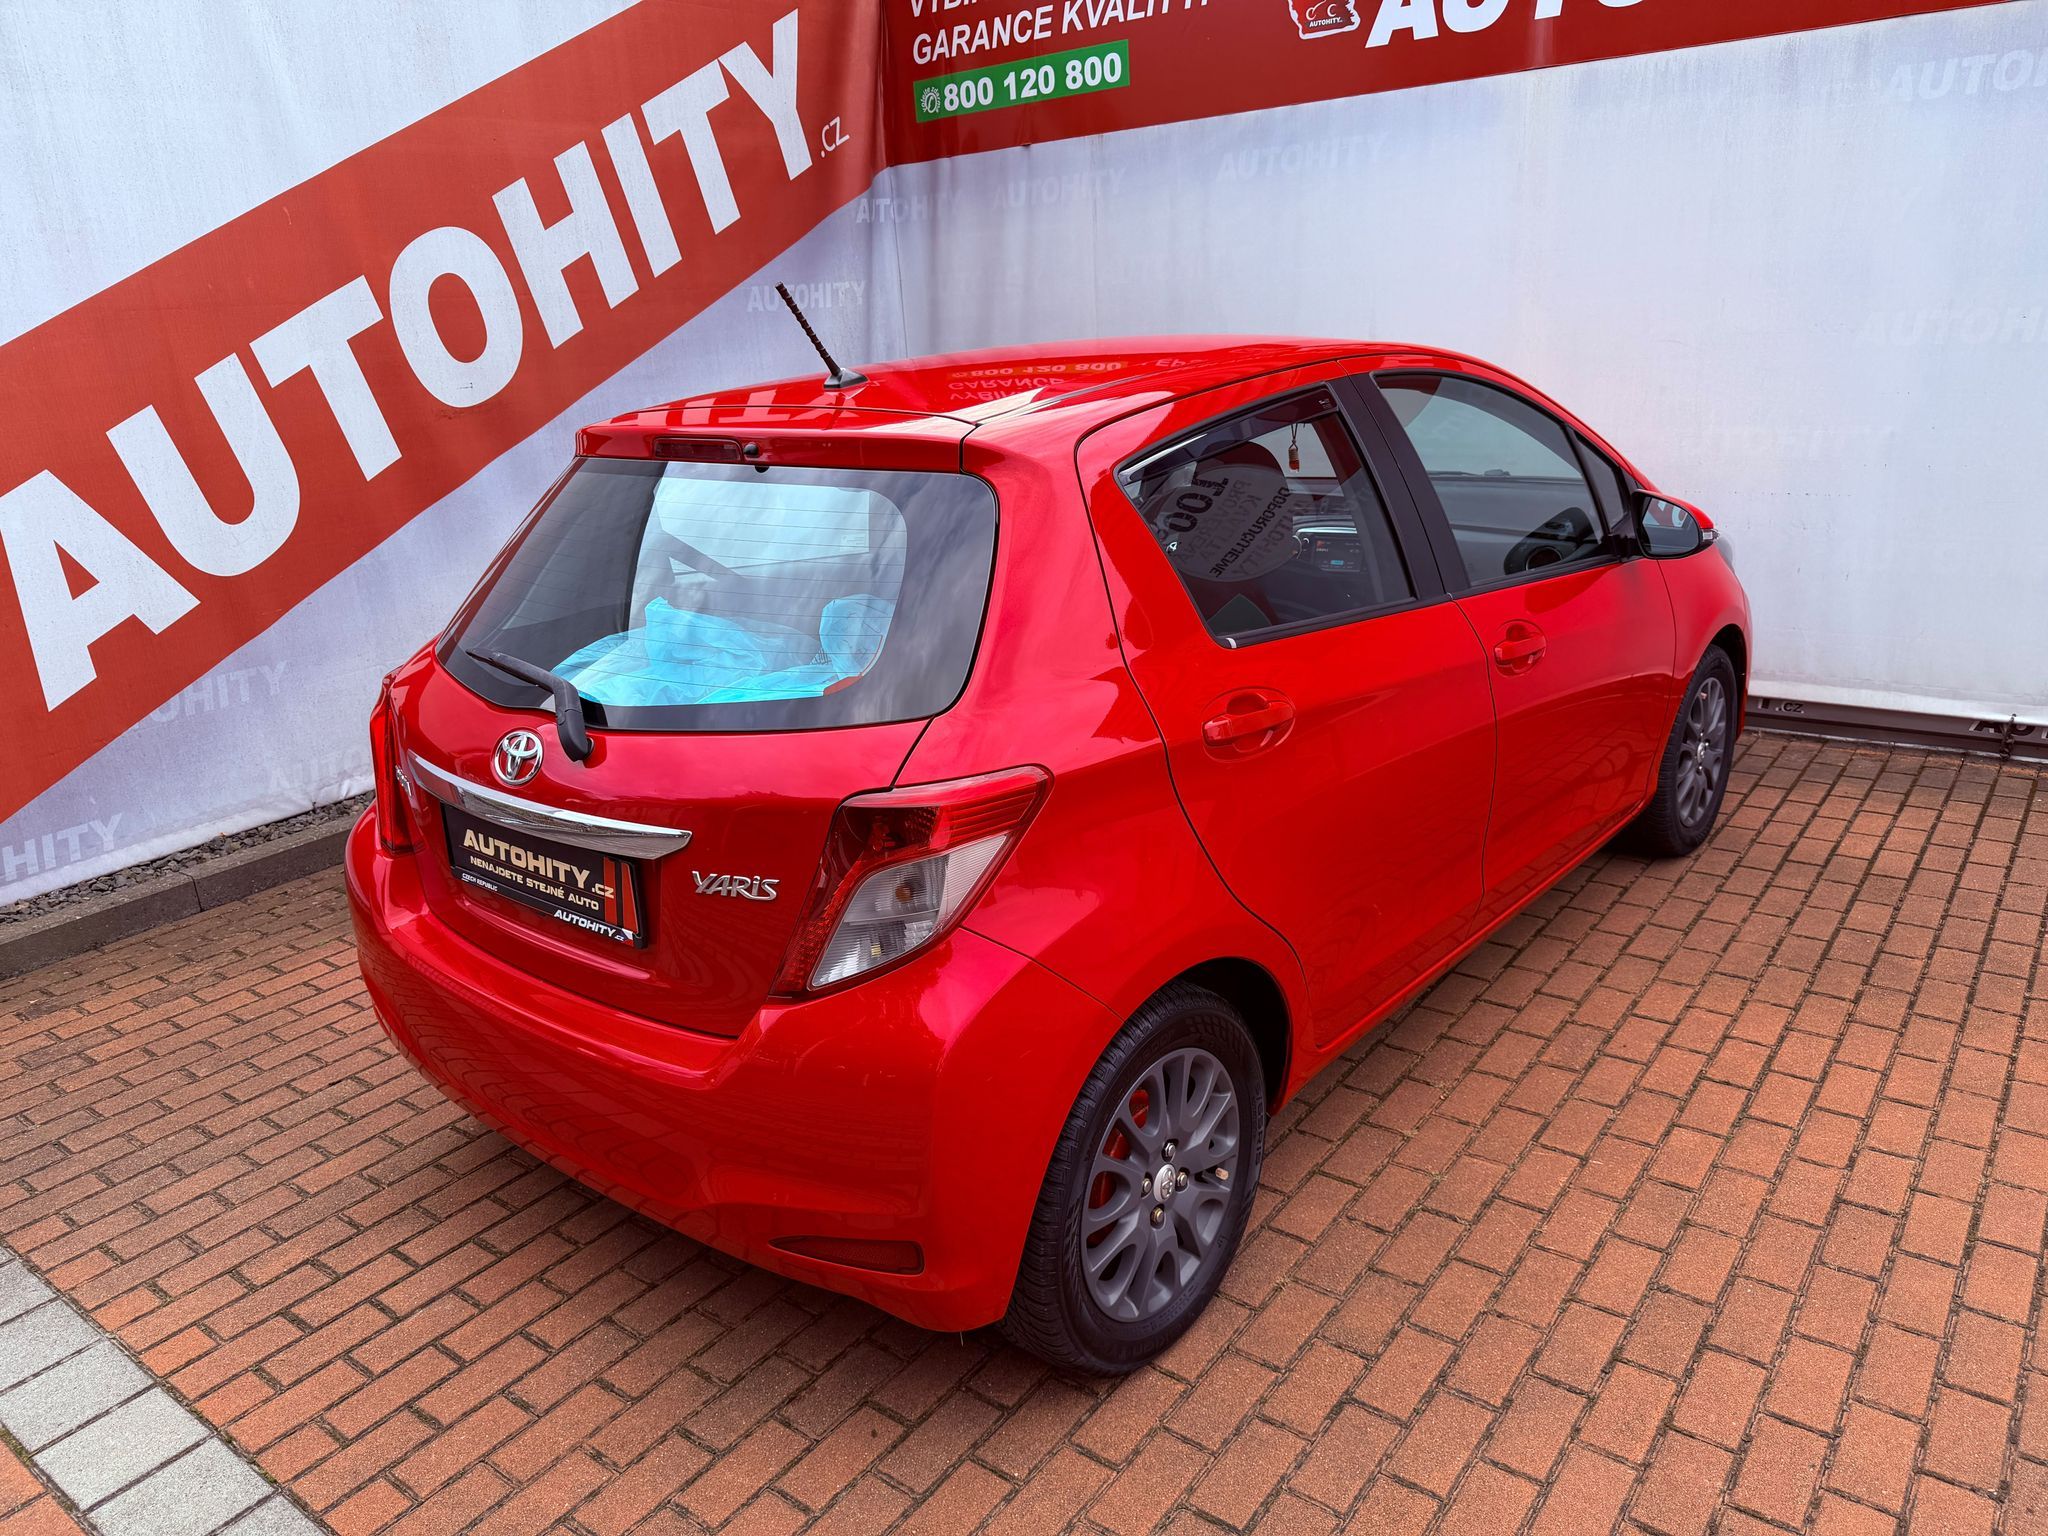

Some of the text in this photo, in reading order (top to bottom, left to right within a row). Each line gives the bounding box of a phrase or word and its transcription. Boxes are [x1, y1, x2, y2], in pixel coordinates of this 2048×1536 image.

[912, 4, 1054, 65] GARANCE
[943, 51, 1122, 112] 800 120 800
[470, 855, 599, 911] NENAJDETE STEJNÉ AUTO
